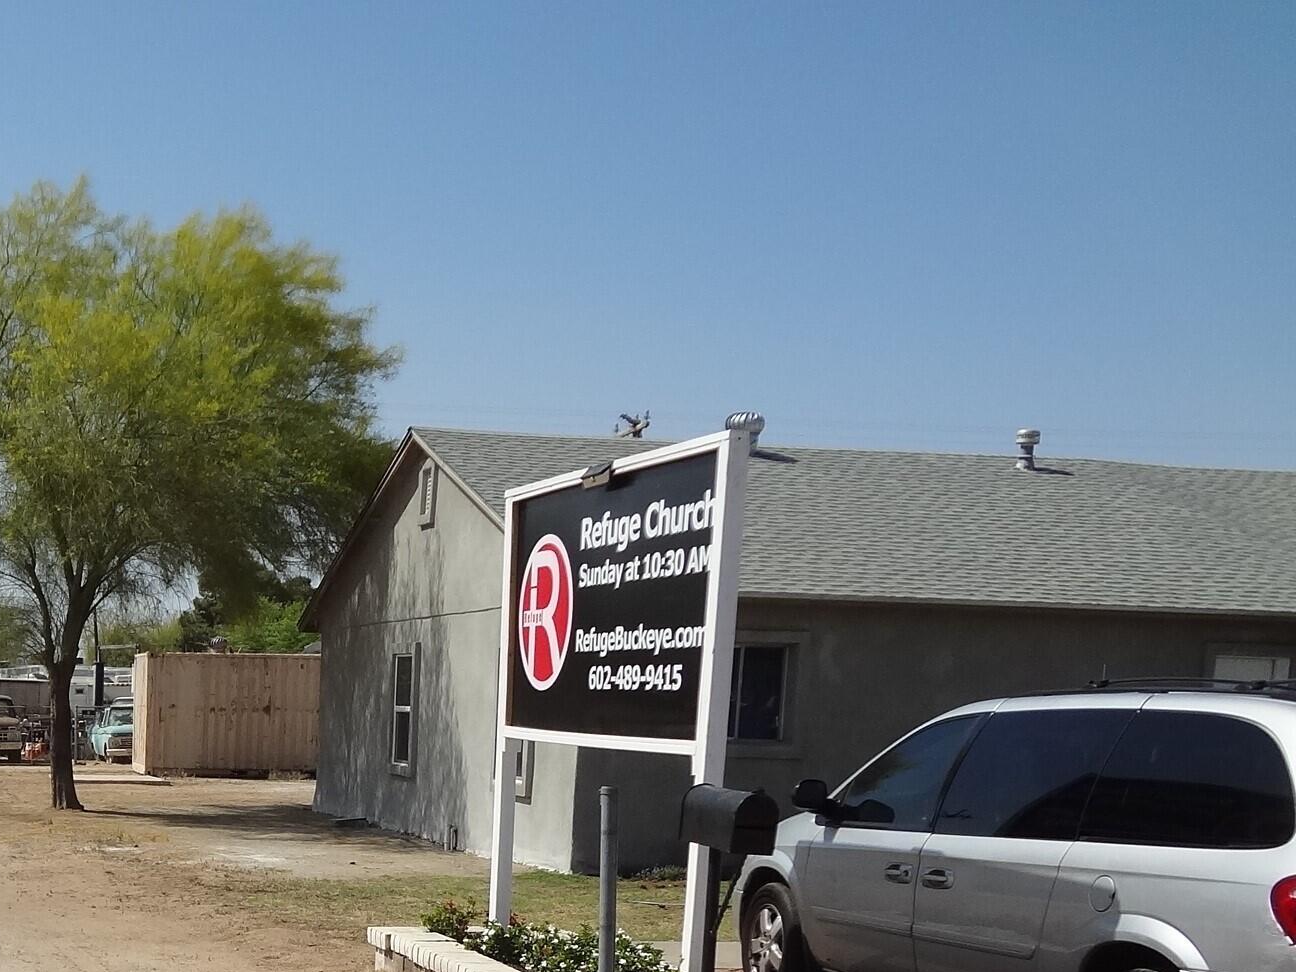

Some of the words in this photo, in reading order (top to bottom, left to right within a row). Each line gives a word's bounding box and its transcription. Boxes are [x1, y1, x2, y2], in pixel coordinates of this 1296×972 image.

[580, 510, 642, 552] Refuge
[645, 489, 716, 539] Church
[578, 559, 625, 589] Sunday
[625, 556, 641, 581] at
[642, 548, 685, 580] 10:30
[685, 544, 713, 575] AM
[575, 623, 706, 657] RefugeBuckeye.com
[588, 664, 683, 691] 602-489-9415
